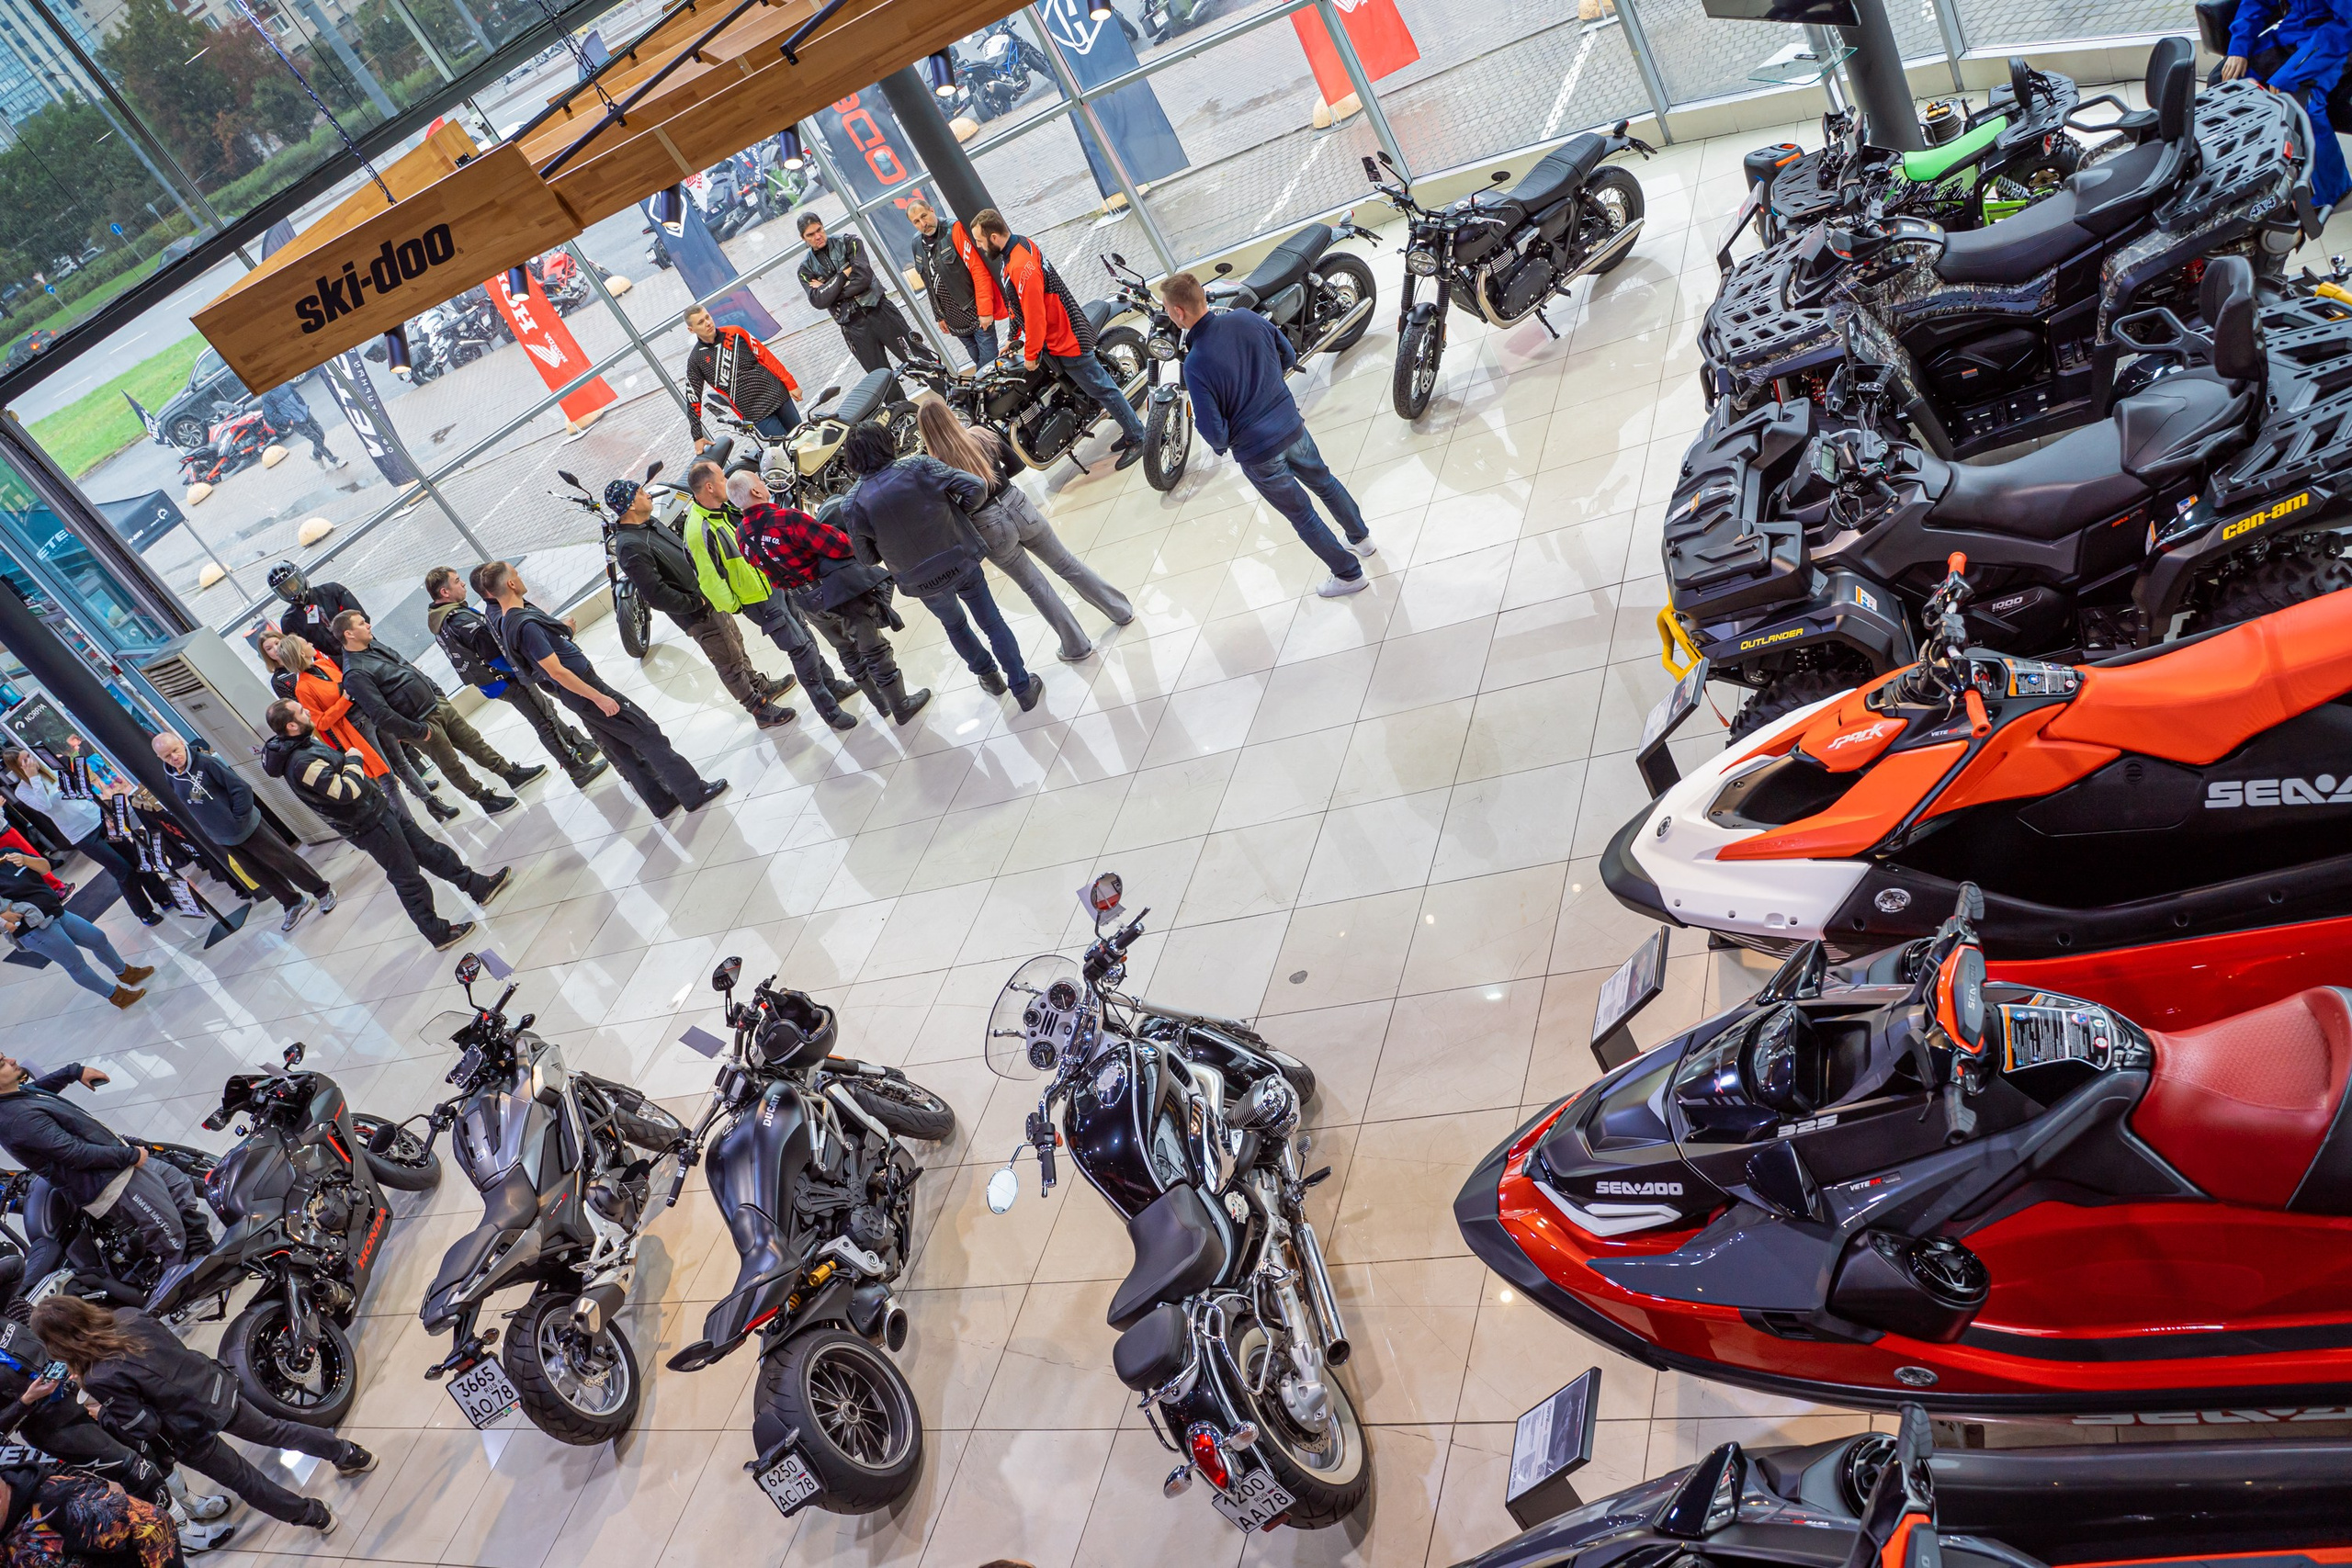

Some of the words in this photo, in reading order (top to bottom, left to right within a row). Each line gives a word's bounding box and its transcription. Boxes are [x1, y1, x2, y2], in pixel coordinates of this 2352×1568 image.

[295, 223, 455, 333] ski-doo
[2222, 492, 2309, 540] can-am
[917, 566, 959, 592] TRIUMPH
[1991, 596, 2023, 610] 1000
[1740, 627, 1804, 650] OUTLANDER
[24, 703, 48, 723] NORPPA
[763, 1094, 781, 1128] DUCATI
[1777, 1114, 1838, 1138] 325
[1849, 1177, 1883, 1191] VETERR
[132, 1194, 153, 1215] BMW
[357, 1207, 387, 1270] HONDA
[457, 1366, 495, 1398] 3665
[483, 1382, 498, 1393] RUS
[469, 1398, 493, 1422] AO
[492, 1385, 514, 1405] 78
[767, 1461, 797, 1486] 6250
[777, 1490, 797, 1509] AC
[796, 1477, 815, 1495] 78
[1224, 1478, 1265, 1508] 1200
[1253, 1492, 1268, 1503] RUS
[1238, 1508, 1267, 1530] AA
[1262, 1493, 1288, 1512] 78
